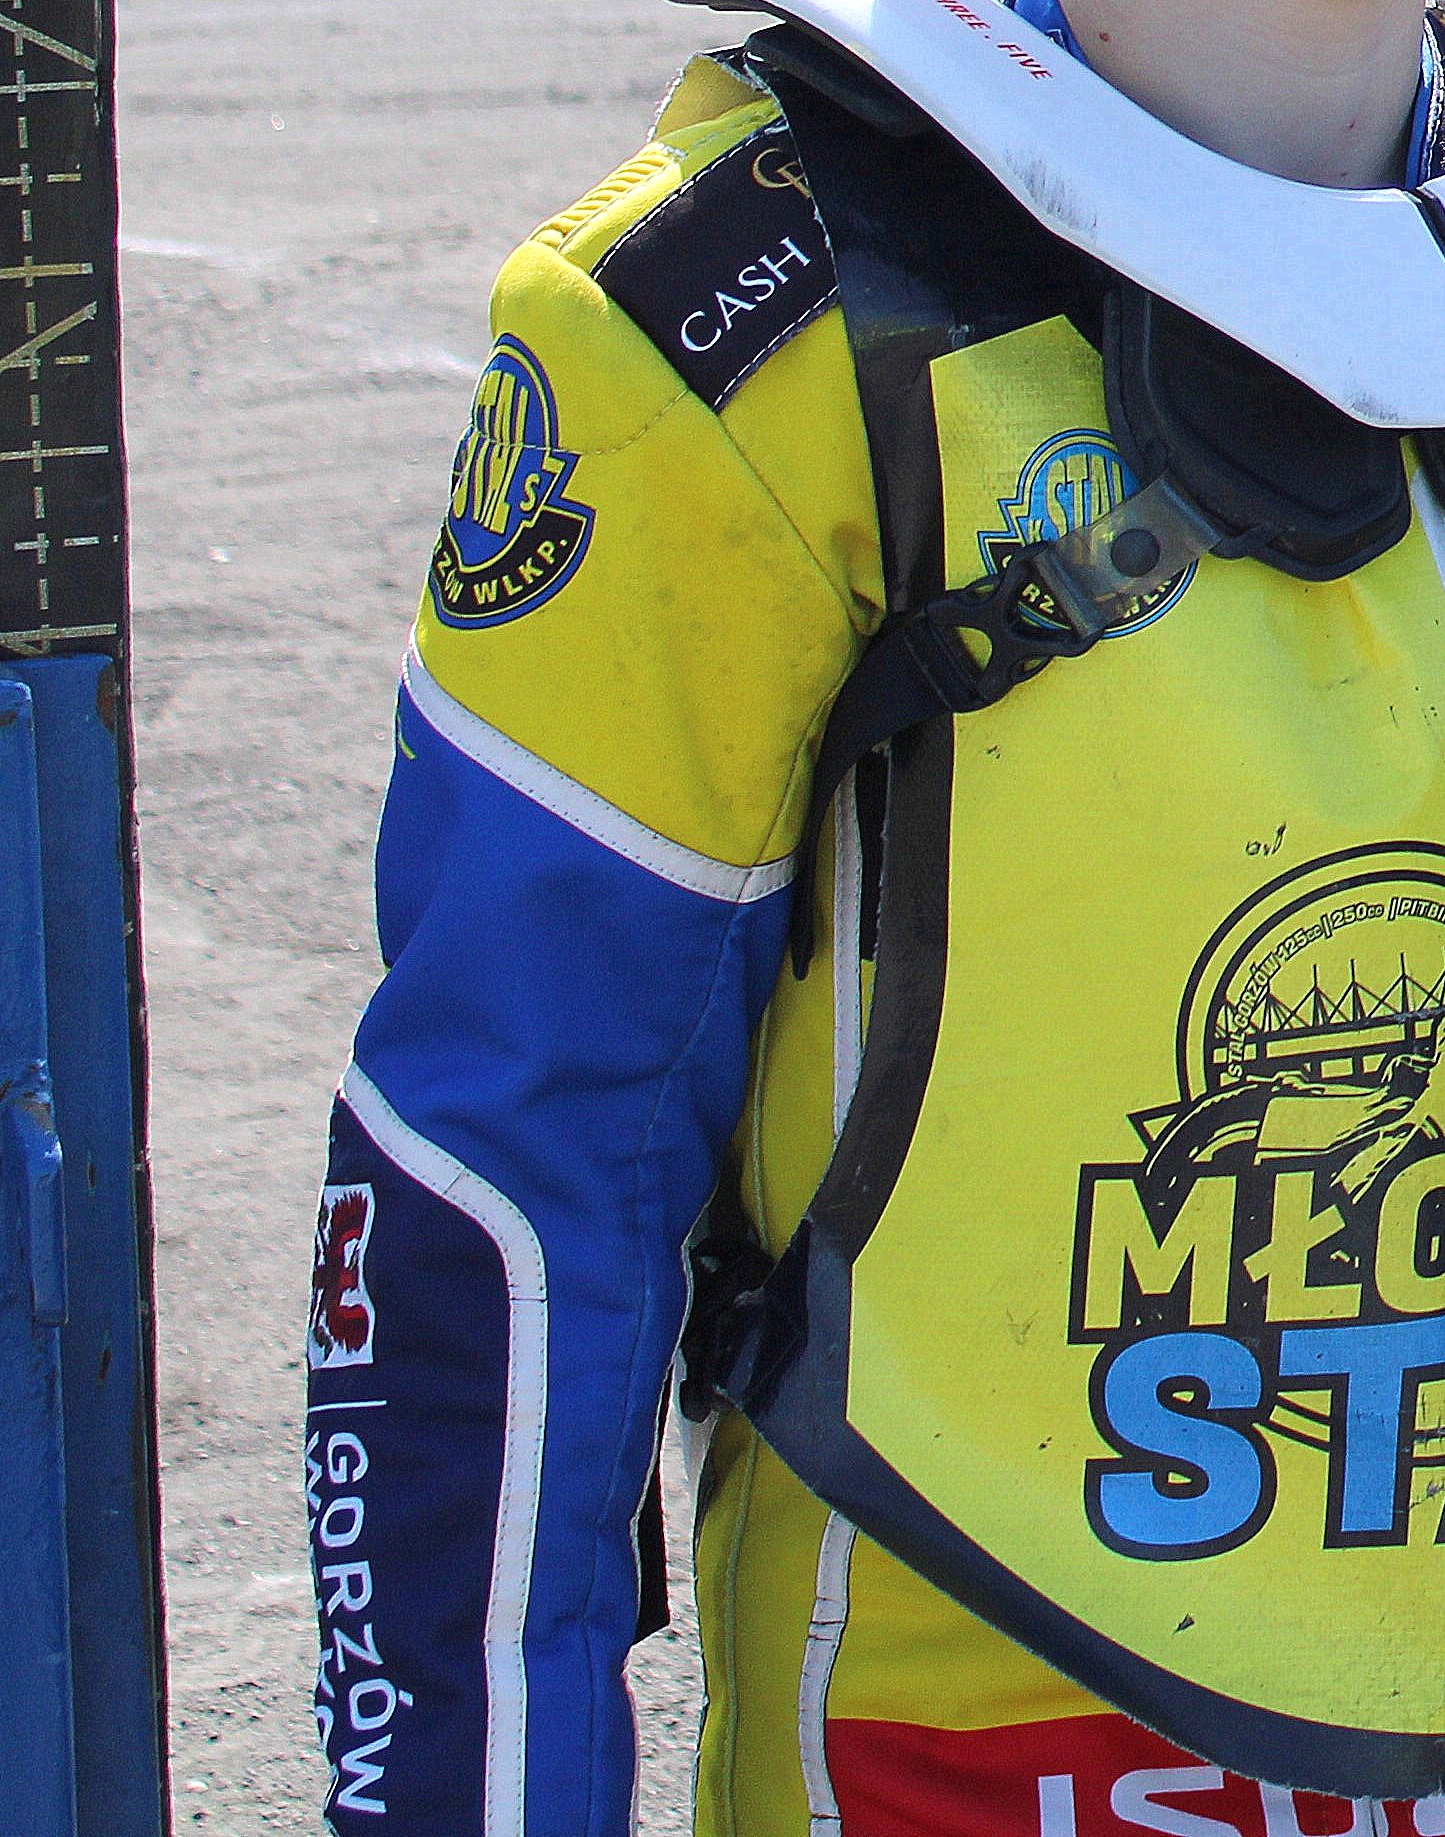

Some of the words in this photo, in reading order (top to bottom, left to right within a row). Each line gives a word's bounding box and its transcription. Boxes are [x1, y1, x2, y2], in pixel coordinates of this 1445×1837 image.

[998, 42, 1054, 83] FIVE
[680, 236, 811, 353] CASH
[472, 538, 569, 605] WLKP.
[319, 1432, 414, 1815] GORZÓW
